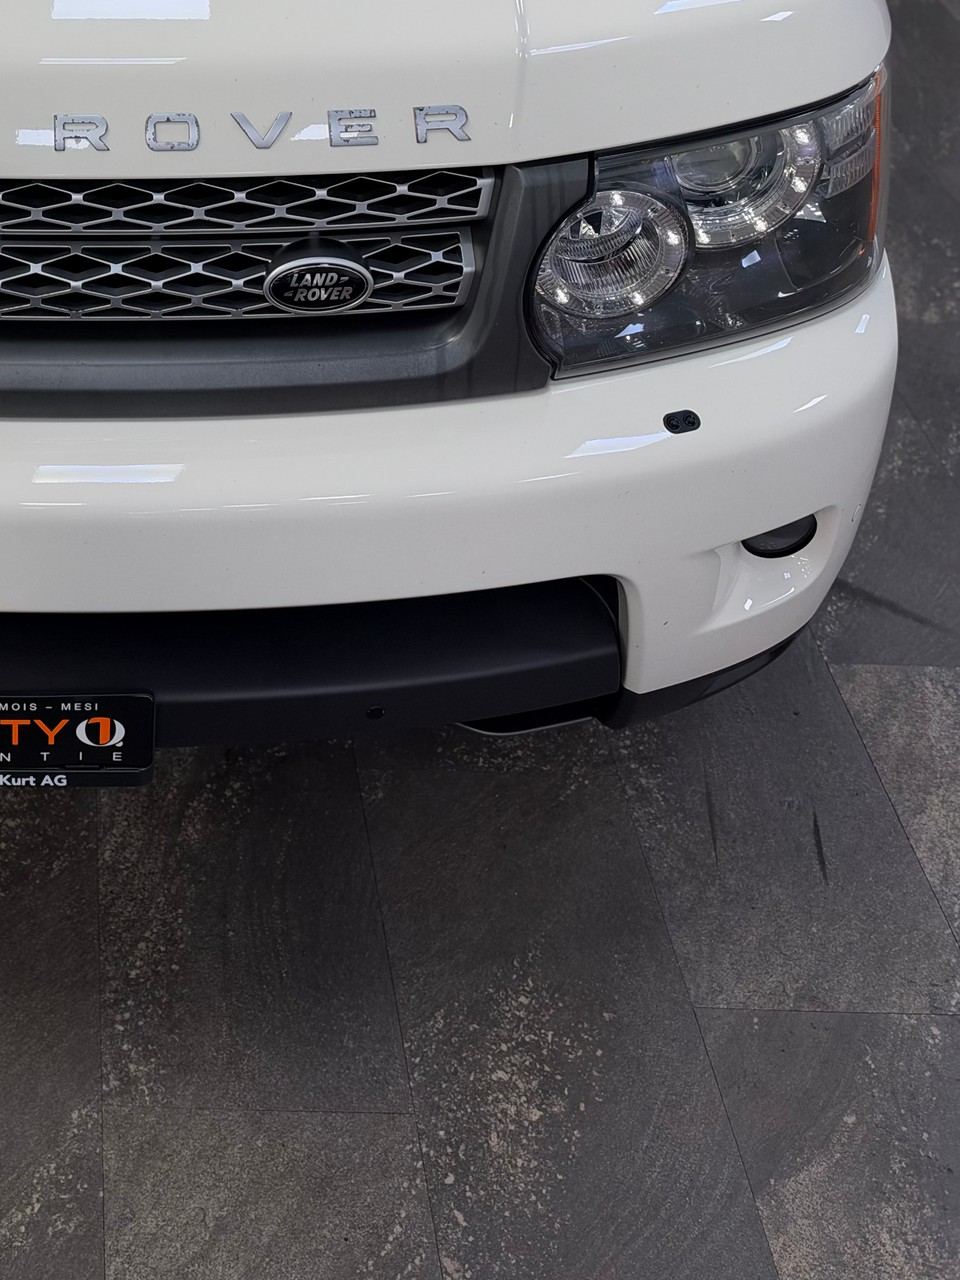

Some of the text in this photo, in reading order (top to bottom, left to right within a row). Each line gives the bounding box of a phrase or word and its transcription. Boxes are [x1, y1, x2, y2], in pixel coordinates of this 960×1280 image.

[53, 104, 472, 152] ROVER
[290, 272, 339, 287] LAND
[293, 286, 353, 301] ROVER
[60, 702, 99, 711] MESI
[0, 773, 36, 786] Kurt
[40, 774, 68, 787] AG
